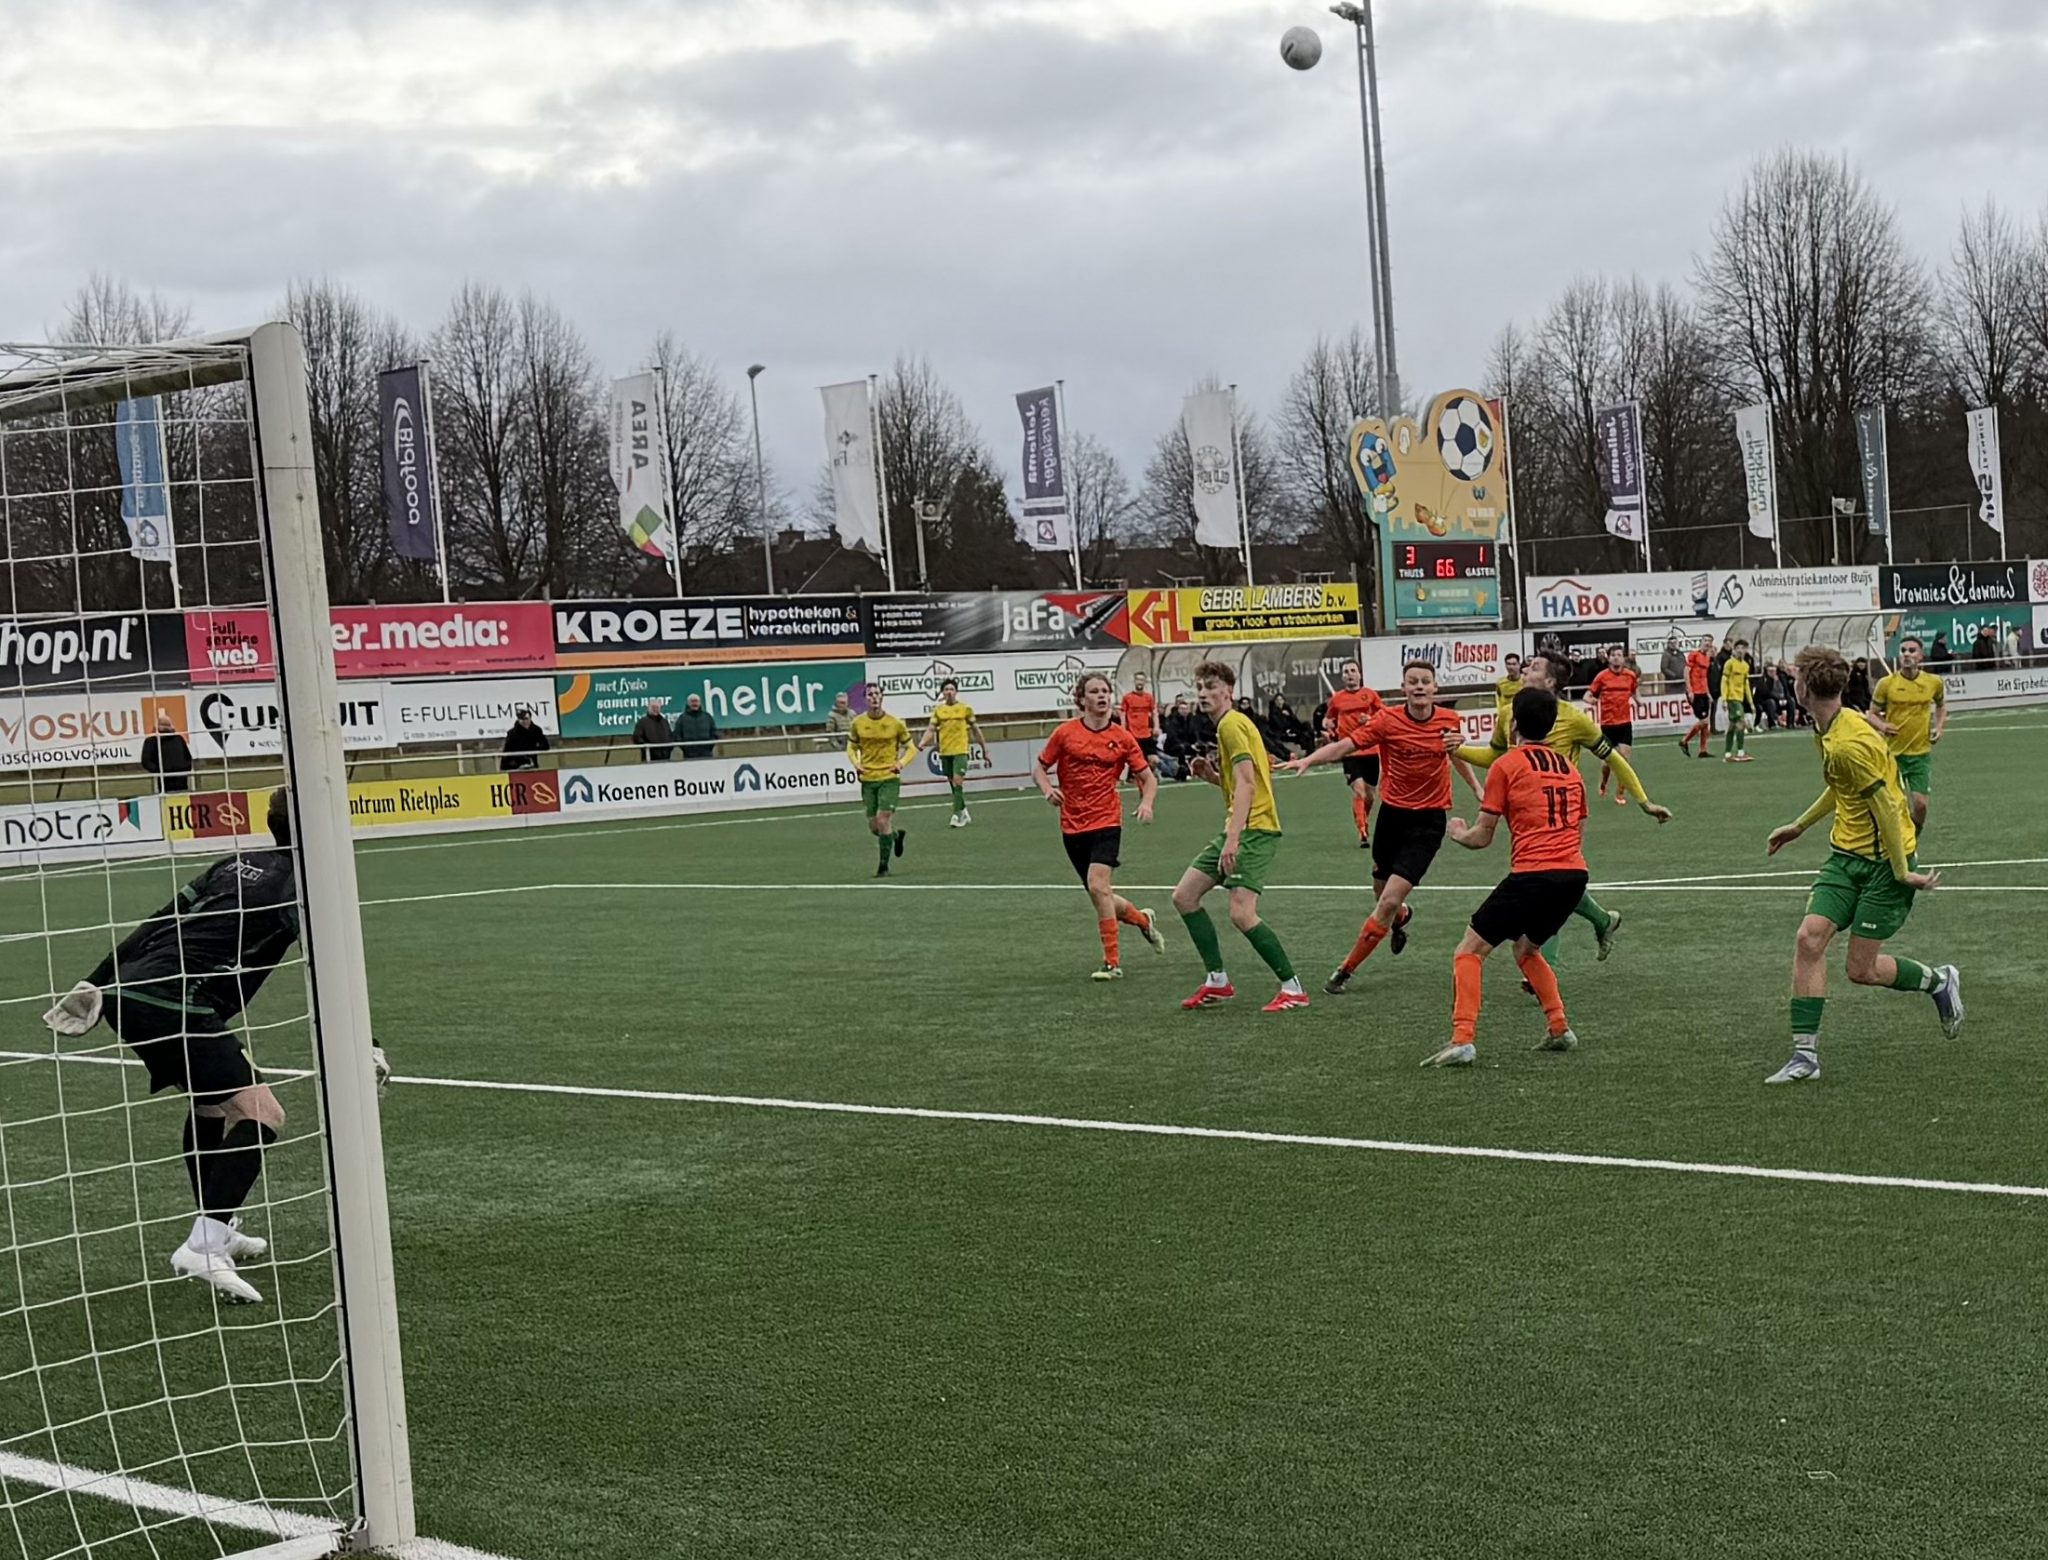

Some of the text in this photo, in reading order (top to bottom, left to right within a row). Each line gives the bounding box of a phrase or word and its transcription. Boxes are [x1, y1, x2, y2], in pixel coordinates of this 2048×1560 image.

[1406, 546, 1485, 577] 3 66 1
[1399, 568, 1424, 578] THUIS
[1250, 585, 1322, 609] LAMBERS
[1542, 594, 1610, 618] HABO
[750, 606, 841, 621] hypotheken
[556, 607, 744, 644] KROEZE
[750, 620, 860, 636] verzekeringen
[207, 641, 259, 666] web
[1454, 642, 1497, 663] Gossen
[595, 680, 617, 693] met
[882, 680, 913, 692] NEW
[1019, 672, 1048, 685] NEW
[597, 698, 638, 709] samen
[703, 675, 824, 717] heldr
[598, 711, 632, 726] beter
[0, 747, 132, 766] IJSCHOOLVOSKUIL
[598, 779, 725, 802] Koenen Bouw
[765, 770, 829, 790] Koenen
[400, 786, 460, 815] Rietplas
[491, 783, 528, 808] HCR
[169, 803, 212, 831] HCR
[1543, 786, 1568, 828] 11
